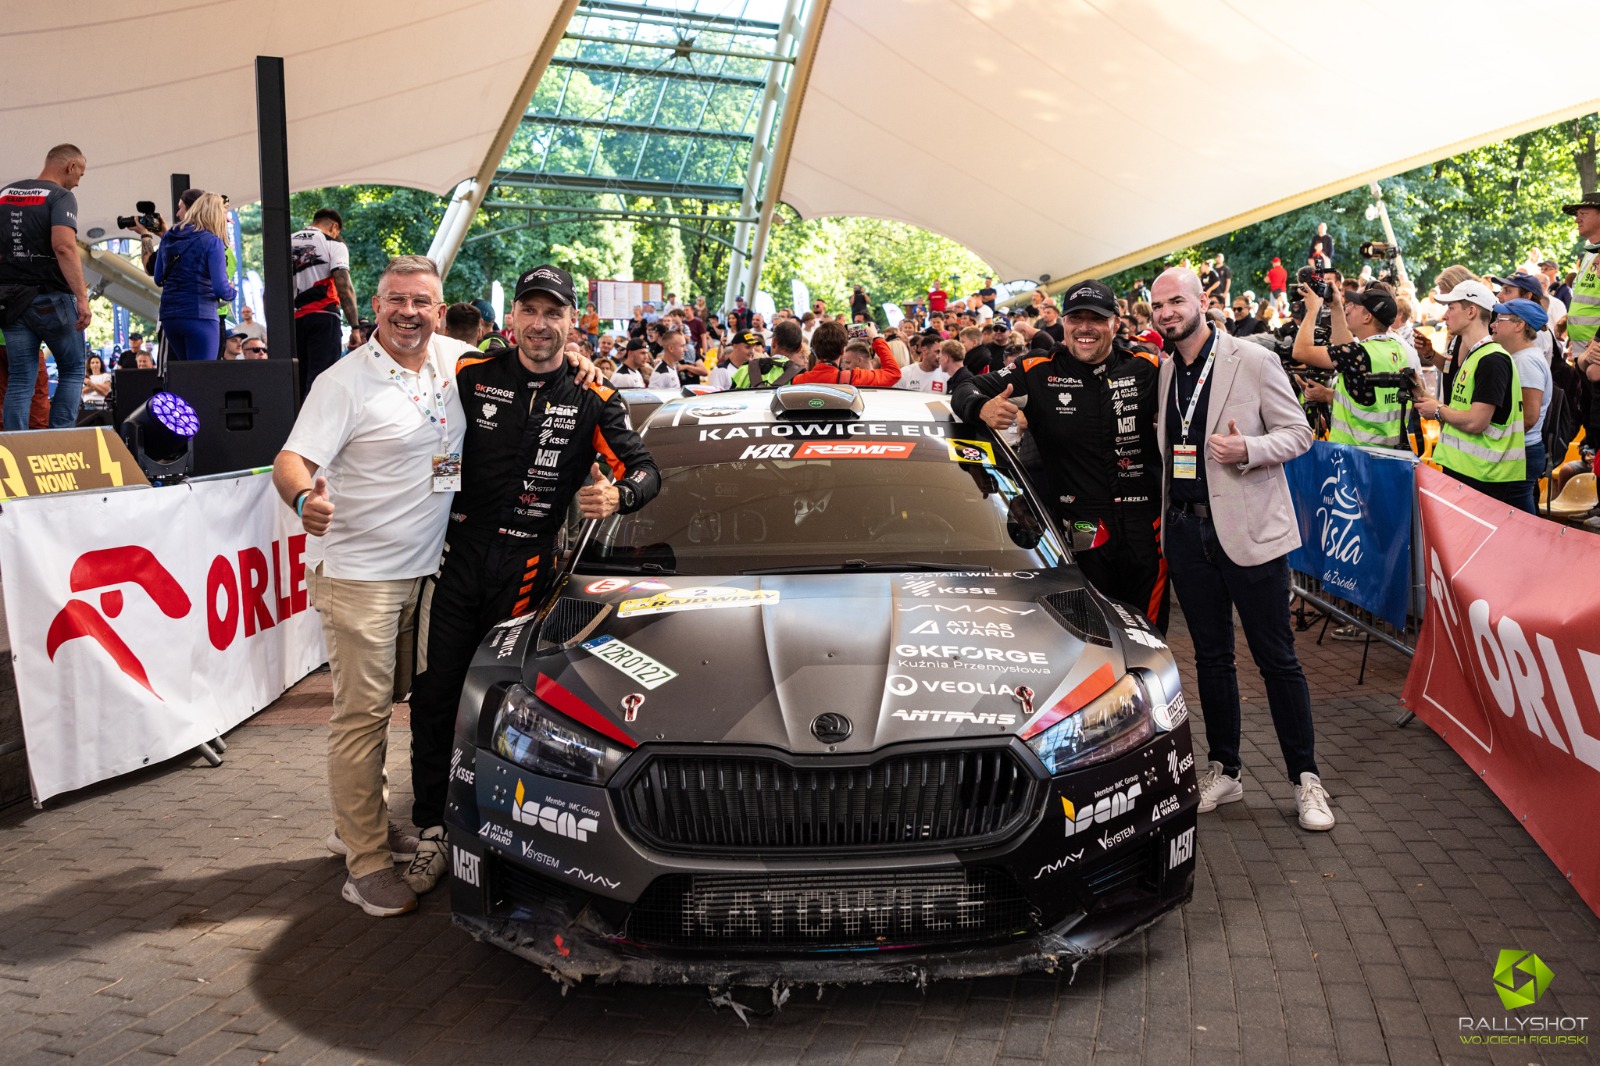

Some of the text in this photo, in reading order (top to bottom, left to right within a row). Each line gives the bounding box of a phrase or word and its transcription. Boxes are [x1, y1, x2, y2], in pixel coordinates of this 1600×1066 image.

[1585, 273, 1595, 281] 98
[475, 383, 515, 399] GKFORGE
[1456, 383, 1466, 393] 57
[1123, 404, 1139, 412] KSSE
[698, 423, 945, 441] KATOWICE.EU
[804, 444, 909, 455] RSMP
[27, 452, 91, 474] ENERGY.
[34, 474, 79, 493] NOW!
[207, 533, 313, 651] ORLE
[938, 587, 998, 595] KSSE
[652, 597, 707, 606] RAJD
[946, 620, 1013, 631] ATLAS
[946, 628, 1016, 639] WARD
[895, 644, 1049, 665] GKFORGE
[898, 659, 1051, 675] Kuźnia Przemysłowa
[922, 680, 1015, 696] VEOLIA
[1178, 753, 1194, 774] KSSE
[456, 766, 475, 785] KSSE
[1094, 785, 1114, 798] Member
[1124, 774, 1139, 786] Group
[1160, 795, 1178, 809] ATLAS
[1161, 802, 1180, 816] WARD
[568, 802, 580, 811] IMC
[581, 806, 600, 818] Group
[490, 832, 511, 846] WARD
[492, 825, 513, 838] ATLAS
